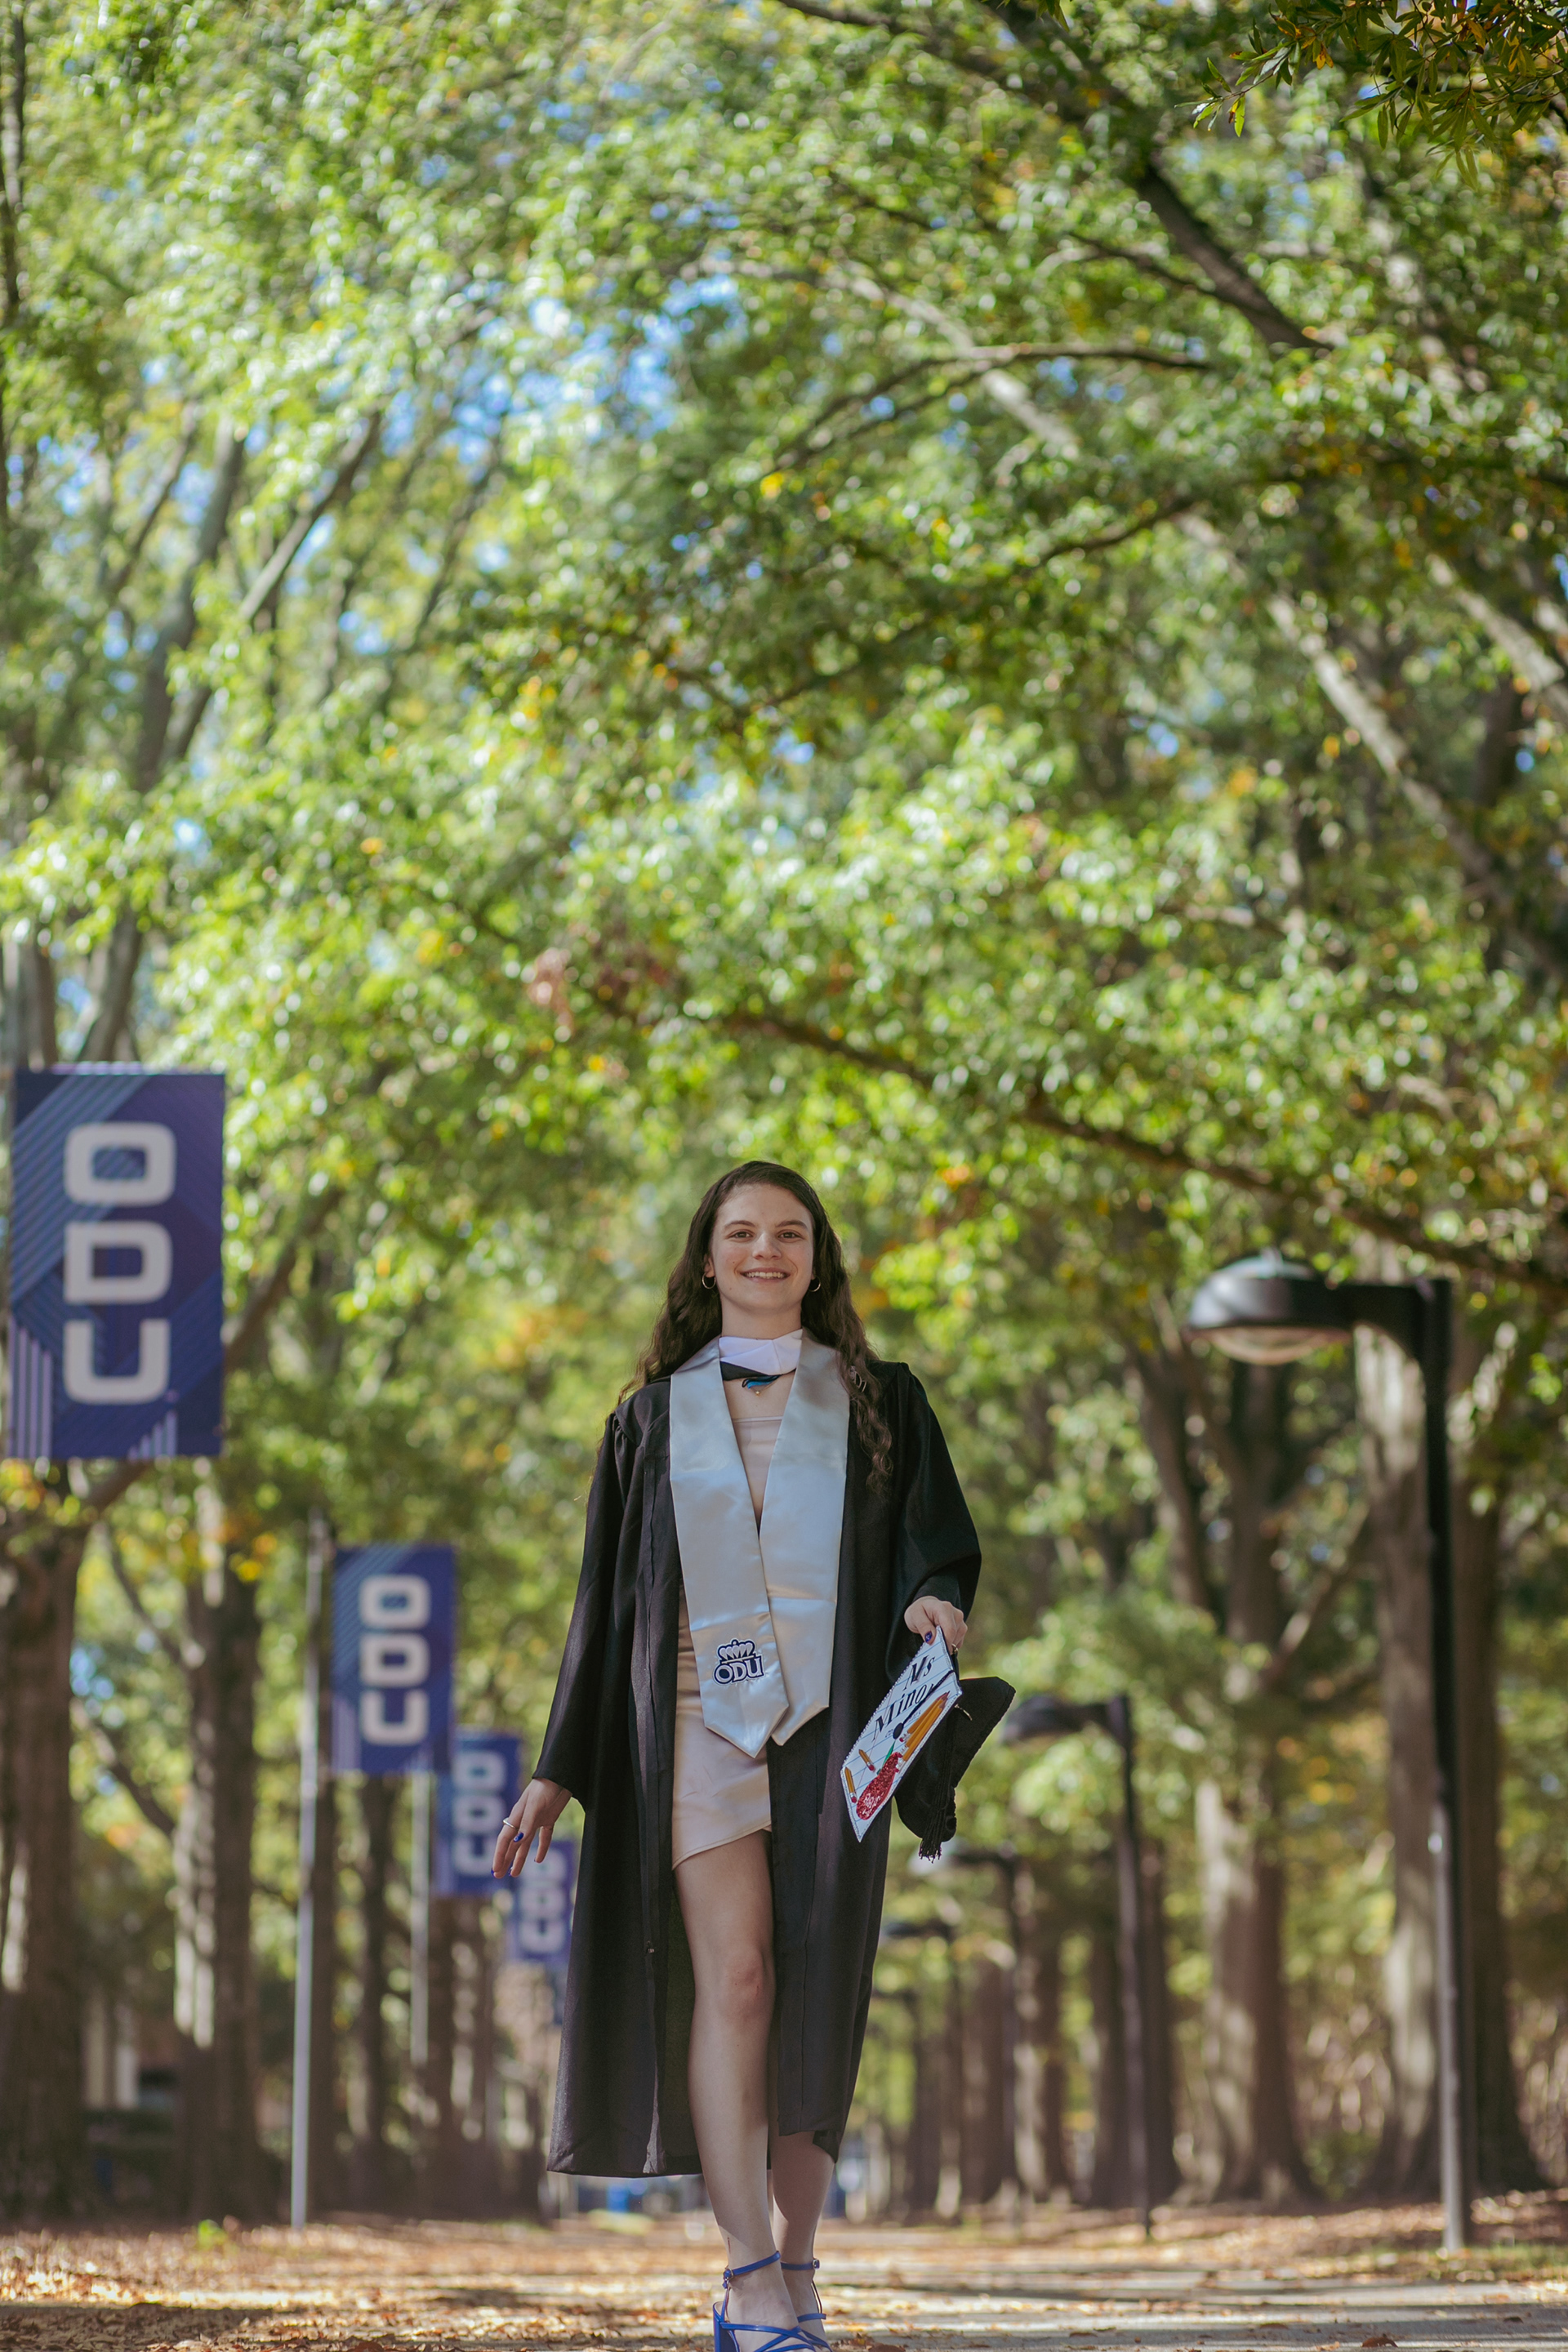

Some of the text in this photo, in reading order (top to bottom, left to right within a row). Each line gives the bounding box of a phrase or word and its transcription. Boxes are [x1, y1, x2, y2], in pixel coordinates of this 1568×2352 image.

[63, 1121, 176, 1405] ODU
[358, 1574, 432, 1746] ODU
[714, 1655, 764, 1685] ODU
